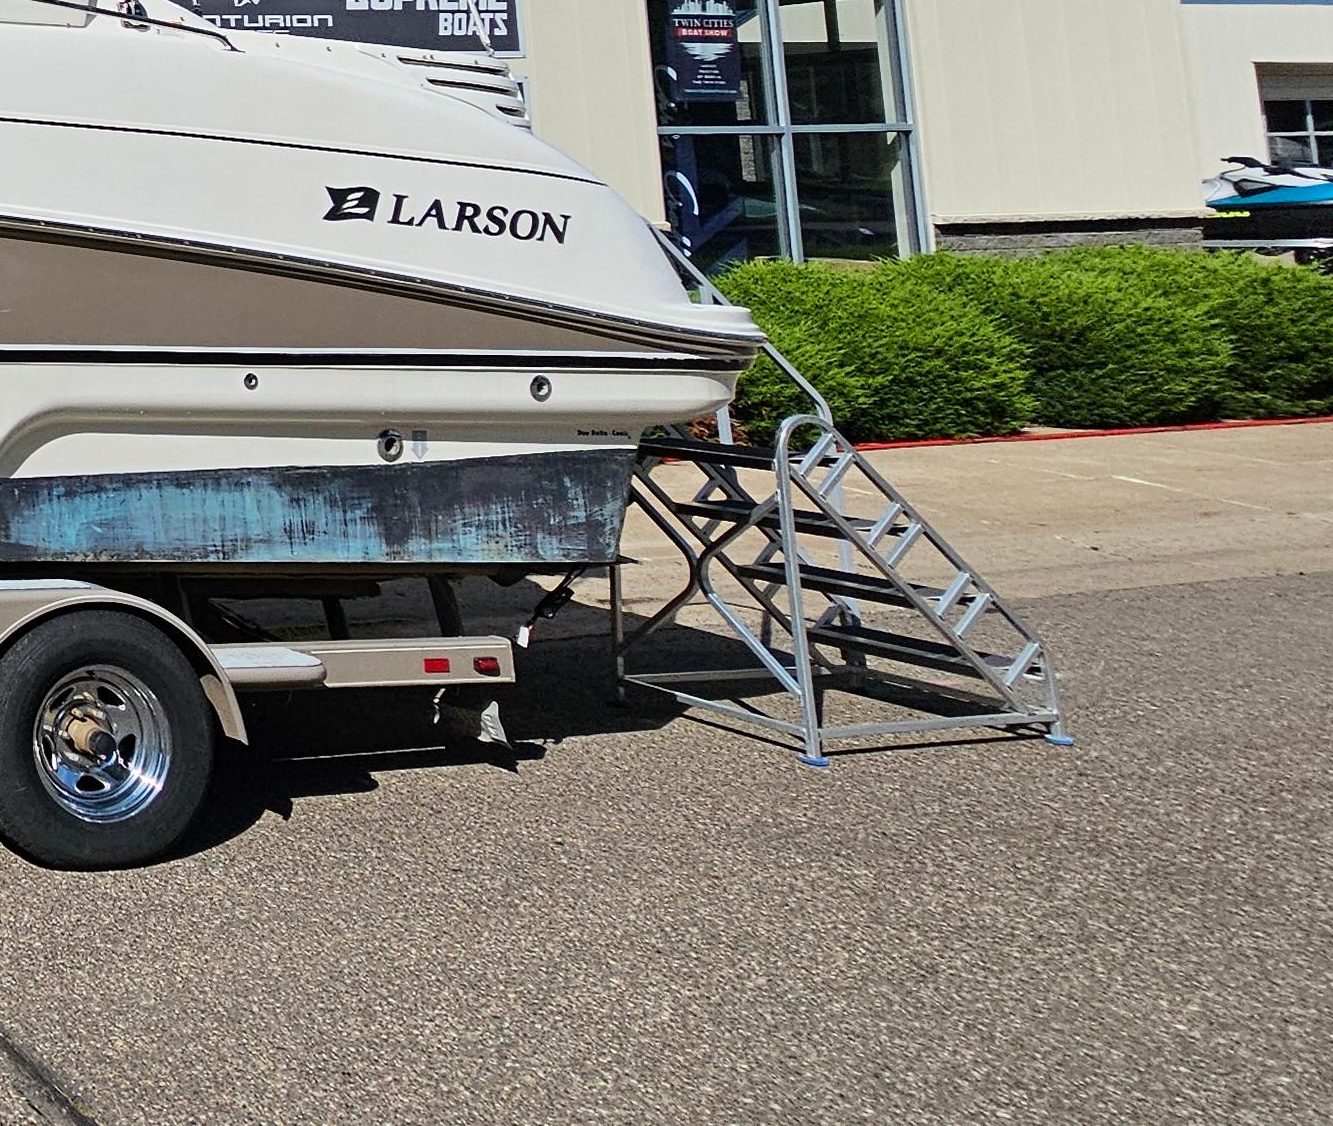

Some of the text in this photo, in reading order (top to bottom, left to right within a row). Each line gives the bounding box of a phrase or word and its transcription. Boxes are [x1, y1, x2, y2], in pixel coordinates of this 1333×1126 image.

[438, 12, 508, 36] BOATS
[673, 18, 734, 28] TWIN CITIES
[681, 28, 729, 37] BOAT SHOW
[386, 193, 573, 245] LARSON
